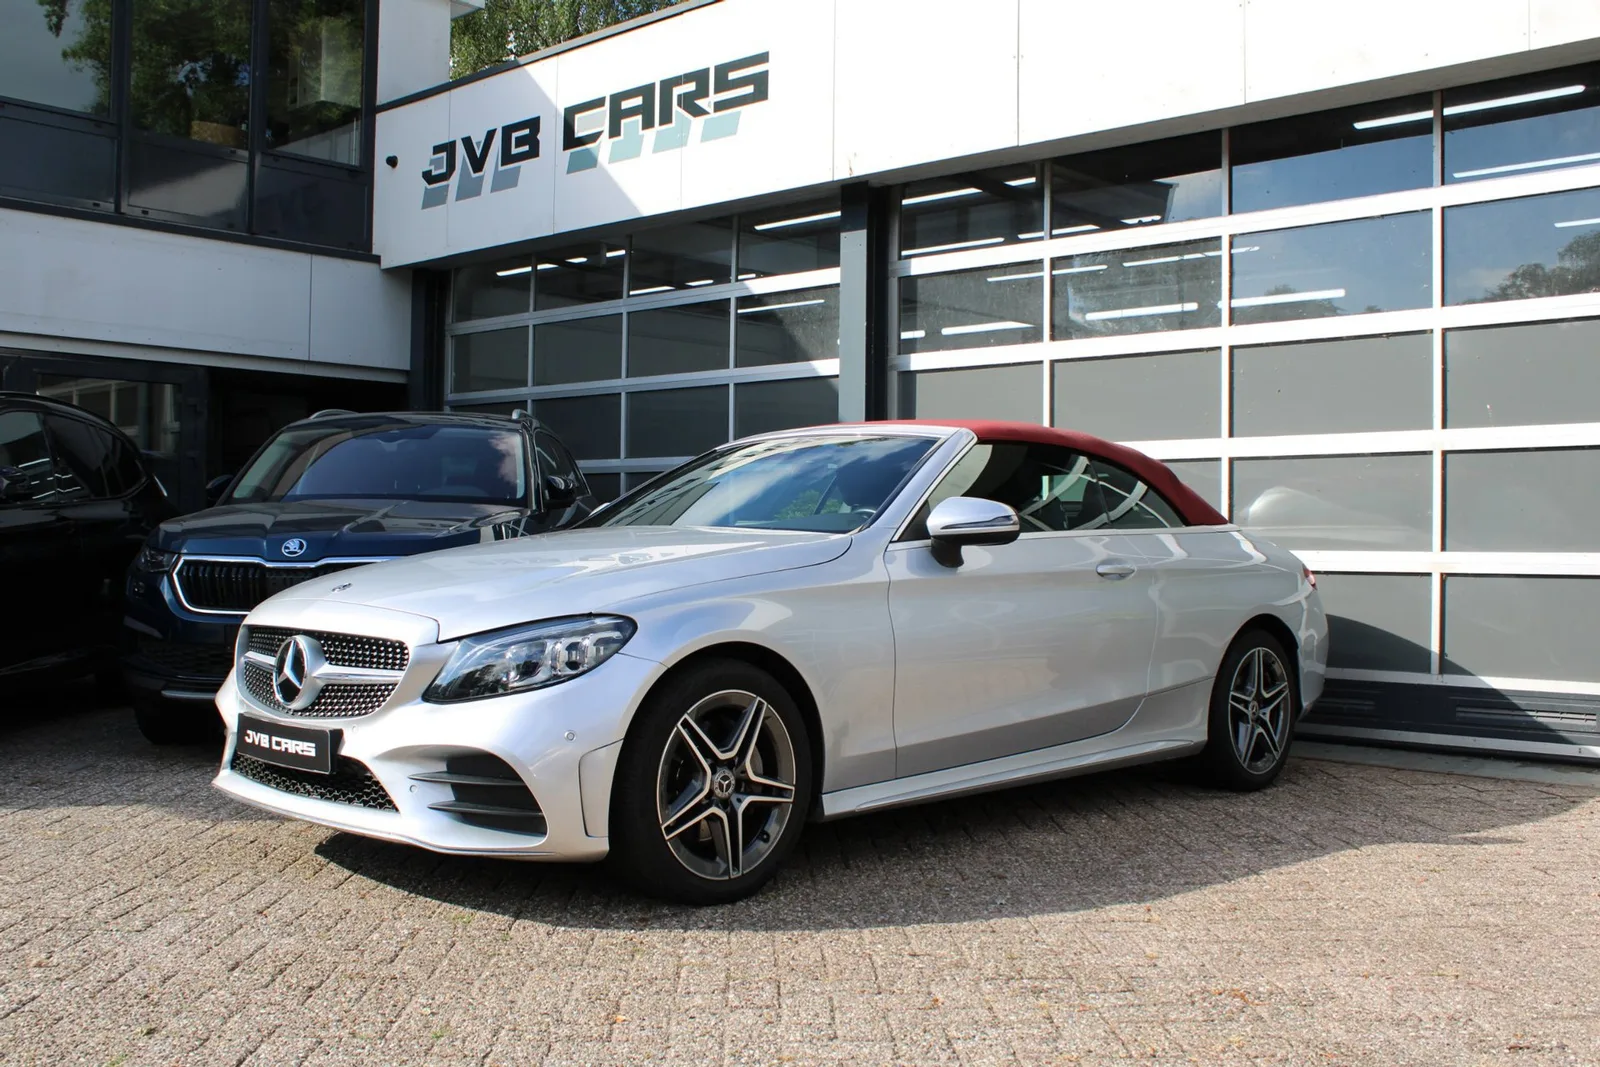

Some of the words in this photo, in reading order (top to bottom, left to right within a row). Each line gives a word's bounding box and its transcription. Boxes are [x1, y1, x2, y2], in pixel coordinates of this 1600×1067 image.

[422, 115, 541, 186] JVB
[563, 51, 770, 152] CARS
[244, 730, 270, 749] JVB
[271, 735, 316, 757] CARS
